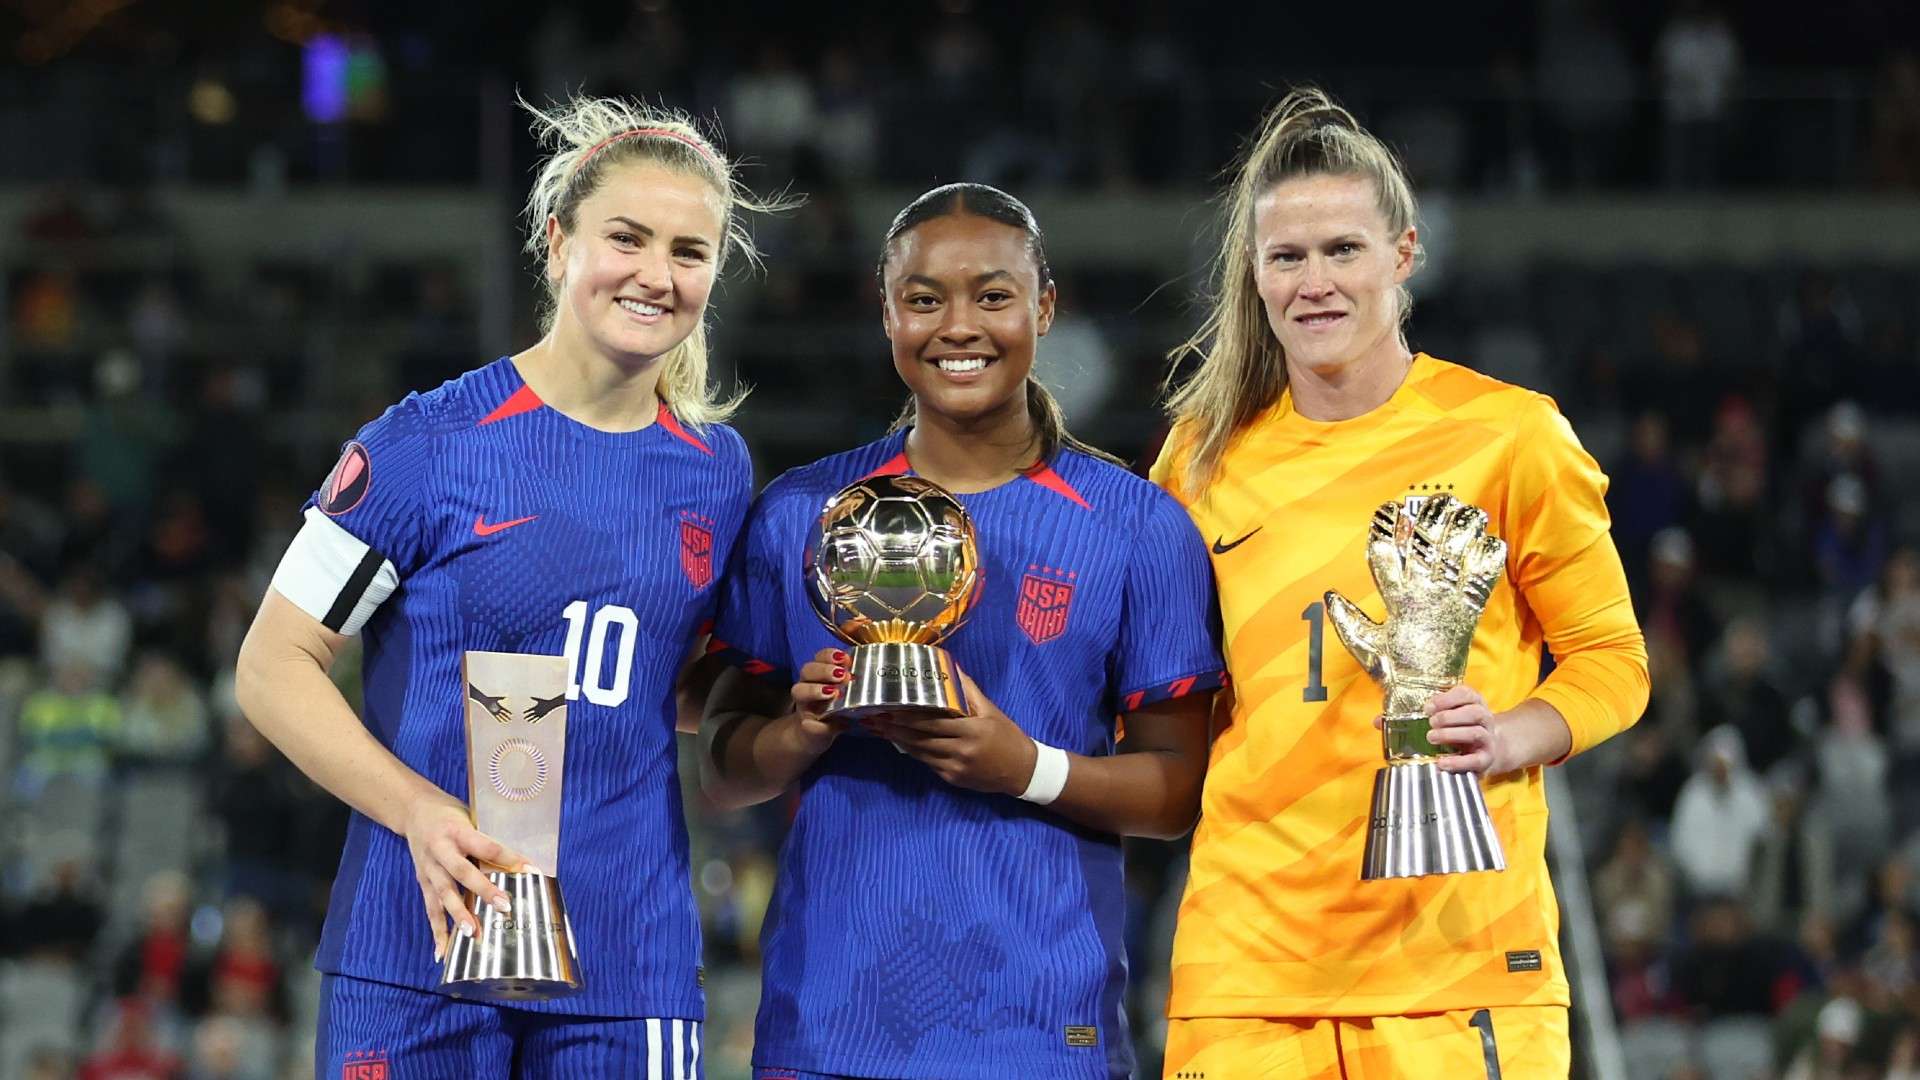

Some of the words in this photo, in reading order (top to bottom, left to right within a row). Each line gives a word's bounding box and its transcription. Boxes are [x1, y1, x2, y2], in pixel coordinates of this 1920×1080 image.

[682, 525, 711, 553] USA
[1024, 578, 1071, 609] USA
[562, 600, 639, 708] 10
[1301, 602, 1327, 702] 1
